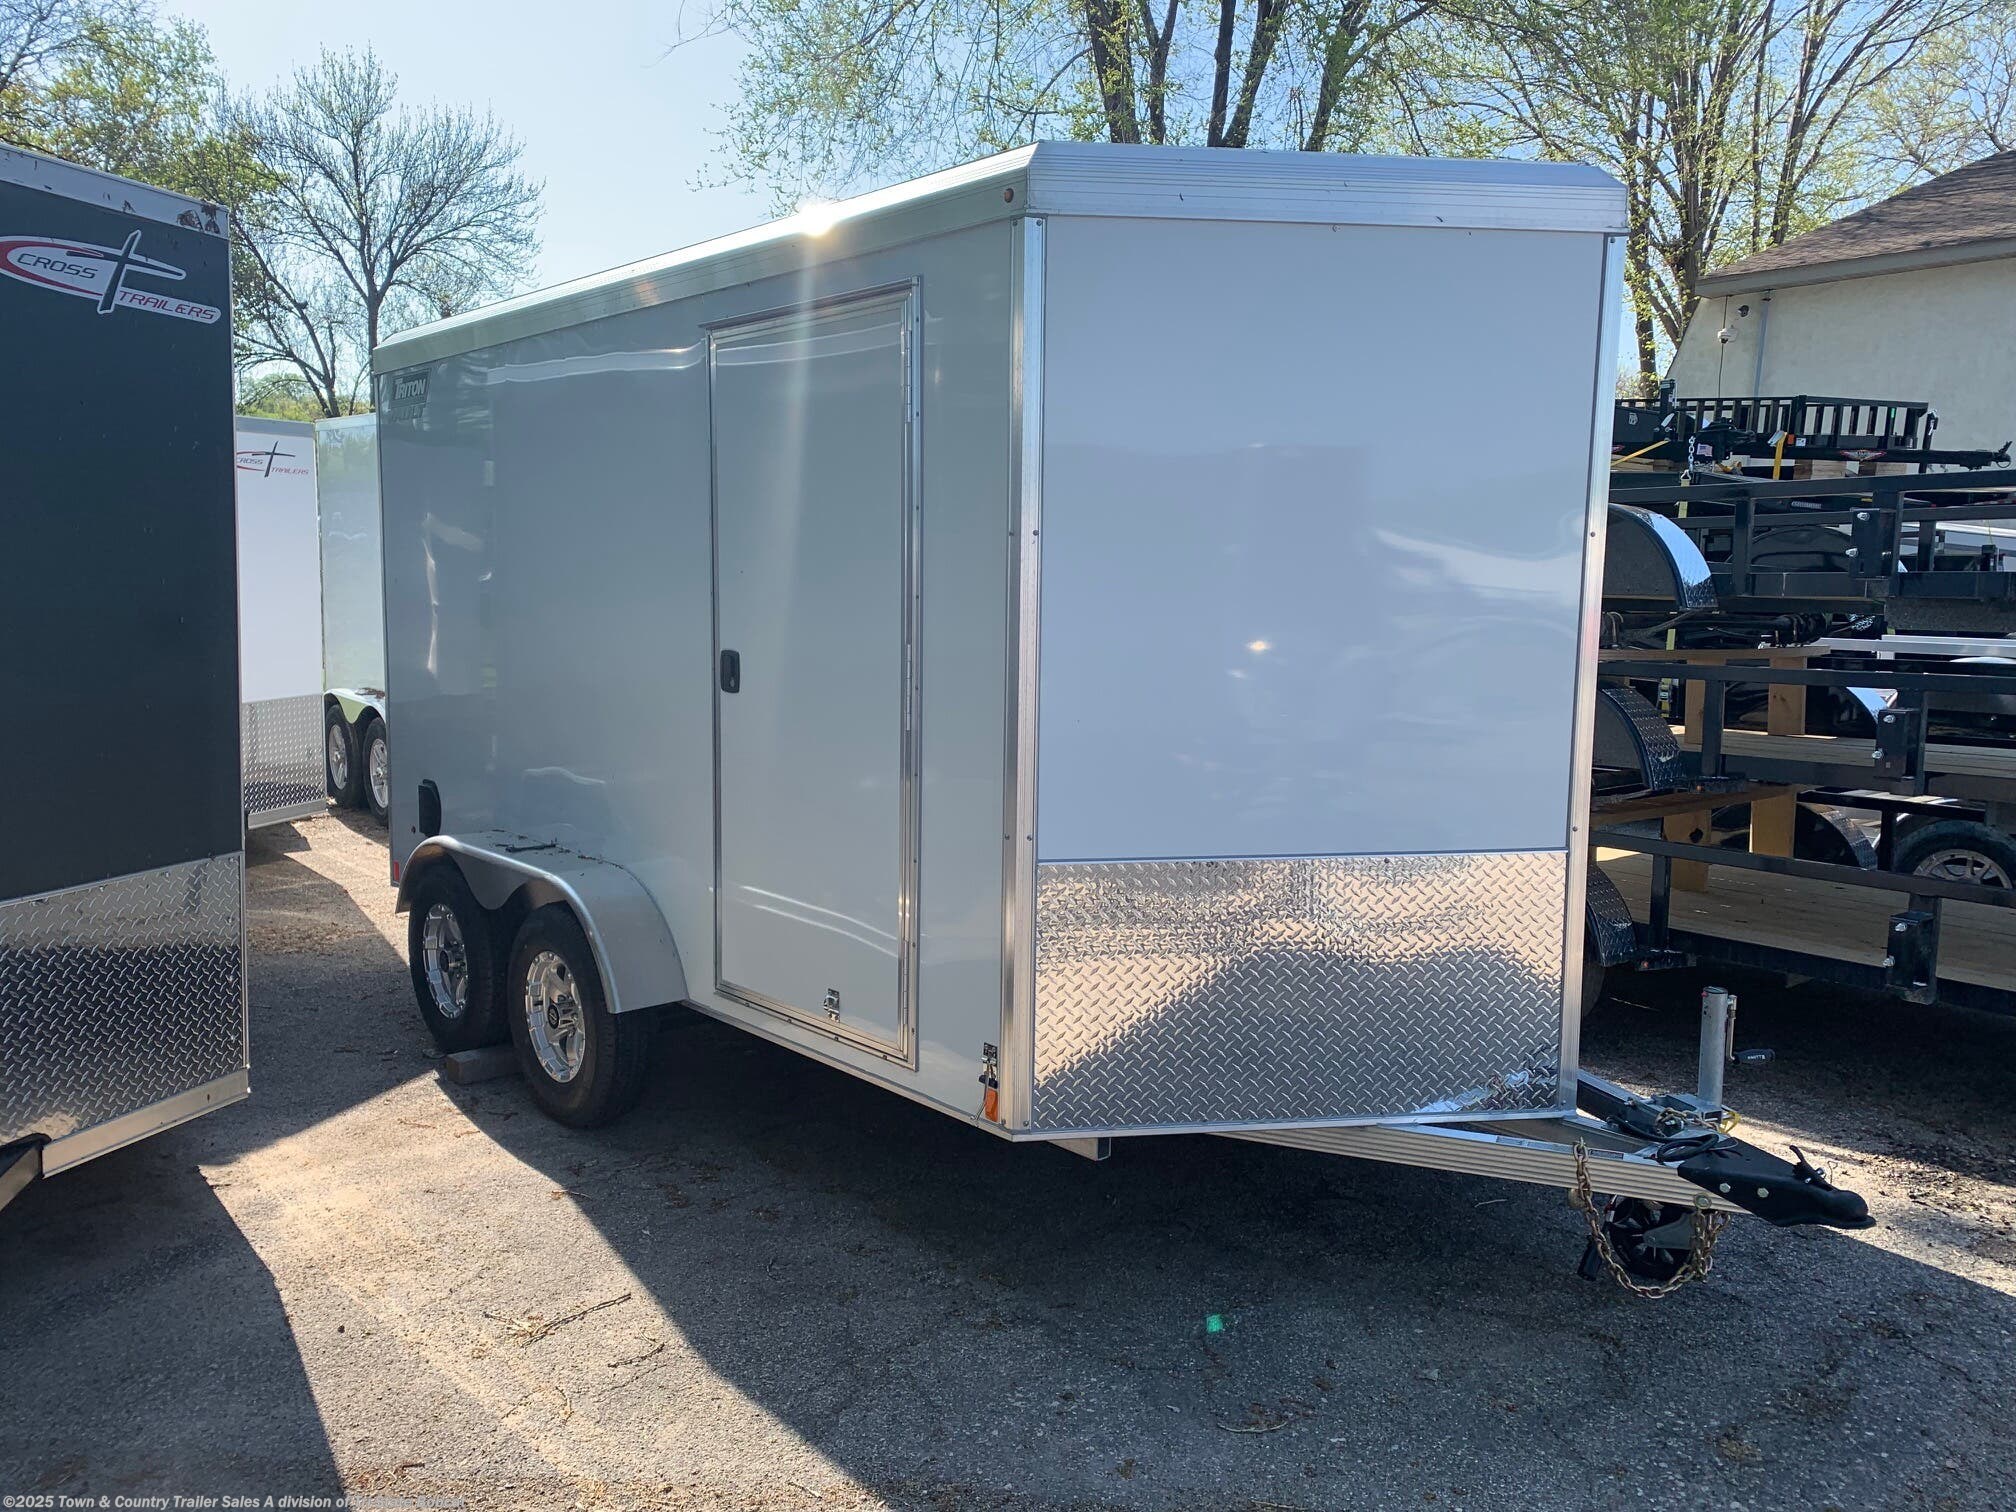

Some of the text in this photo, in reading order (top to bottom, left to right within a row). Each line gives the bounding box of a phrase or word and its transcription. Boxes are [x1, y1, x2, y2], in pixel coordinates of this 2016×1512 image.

[17, 253, 98, 279] CROSS
[118, 290, 217, 320] TRAILERS
[394, 378, 426, 400] TRITON
